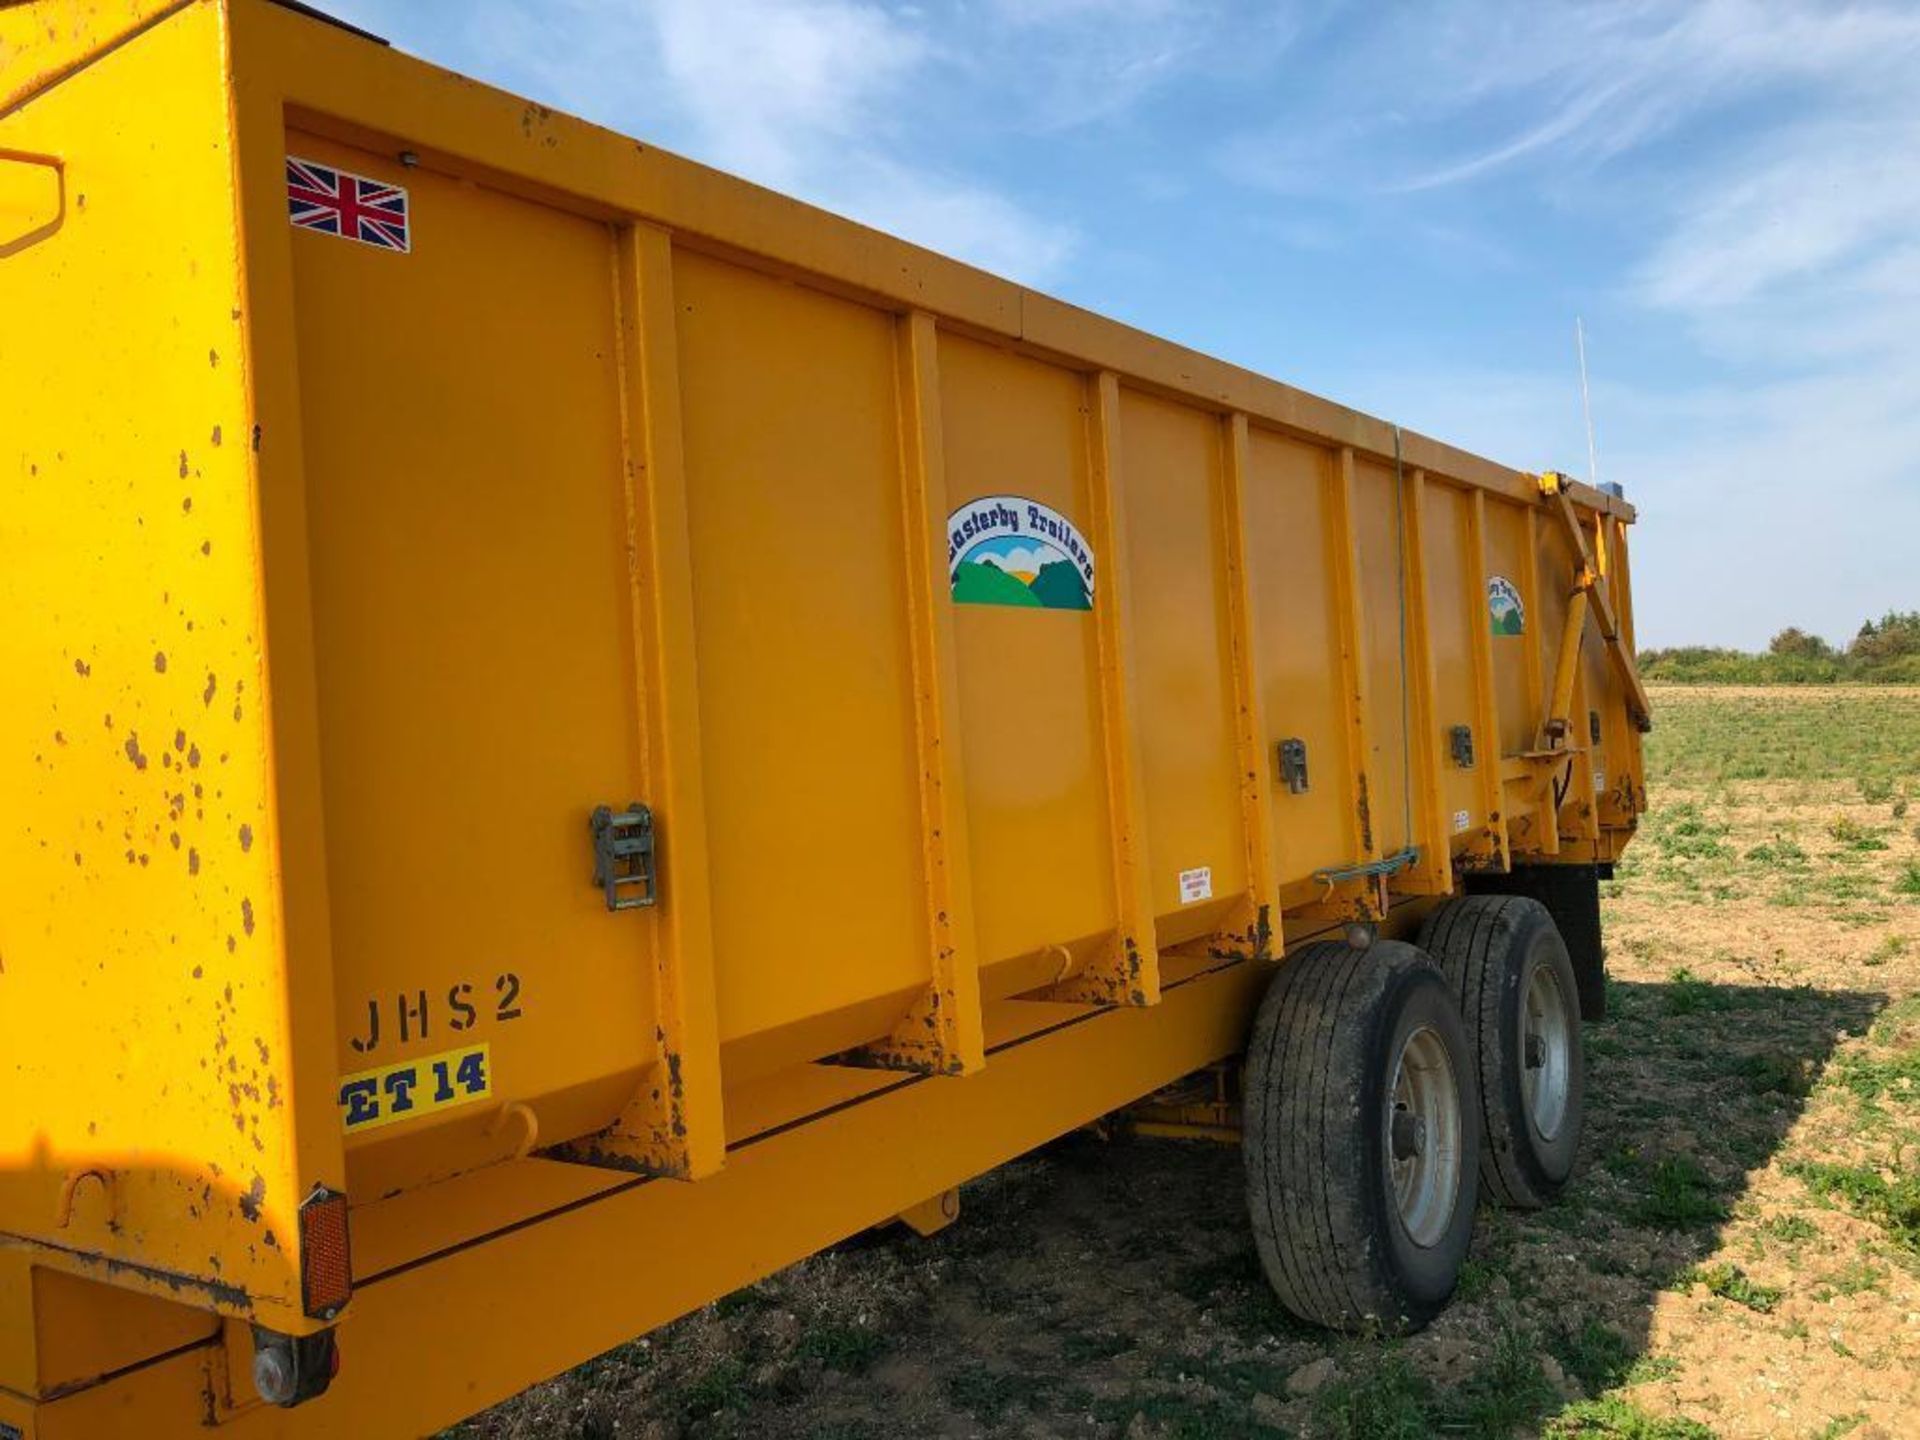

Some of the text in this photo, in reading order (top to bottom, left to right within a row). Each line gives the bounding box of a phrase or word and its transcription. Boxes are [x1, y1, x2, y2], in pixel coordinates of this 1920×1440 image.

[1028, 505, 1093, 580] Trailers
[338, 1052, 487, 1126] ET 14
